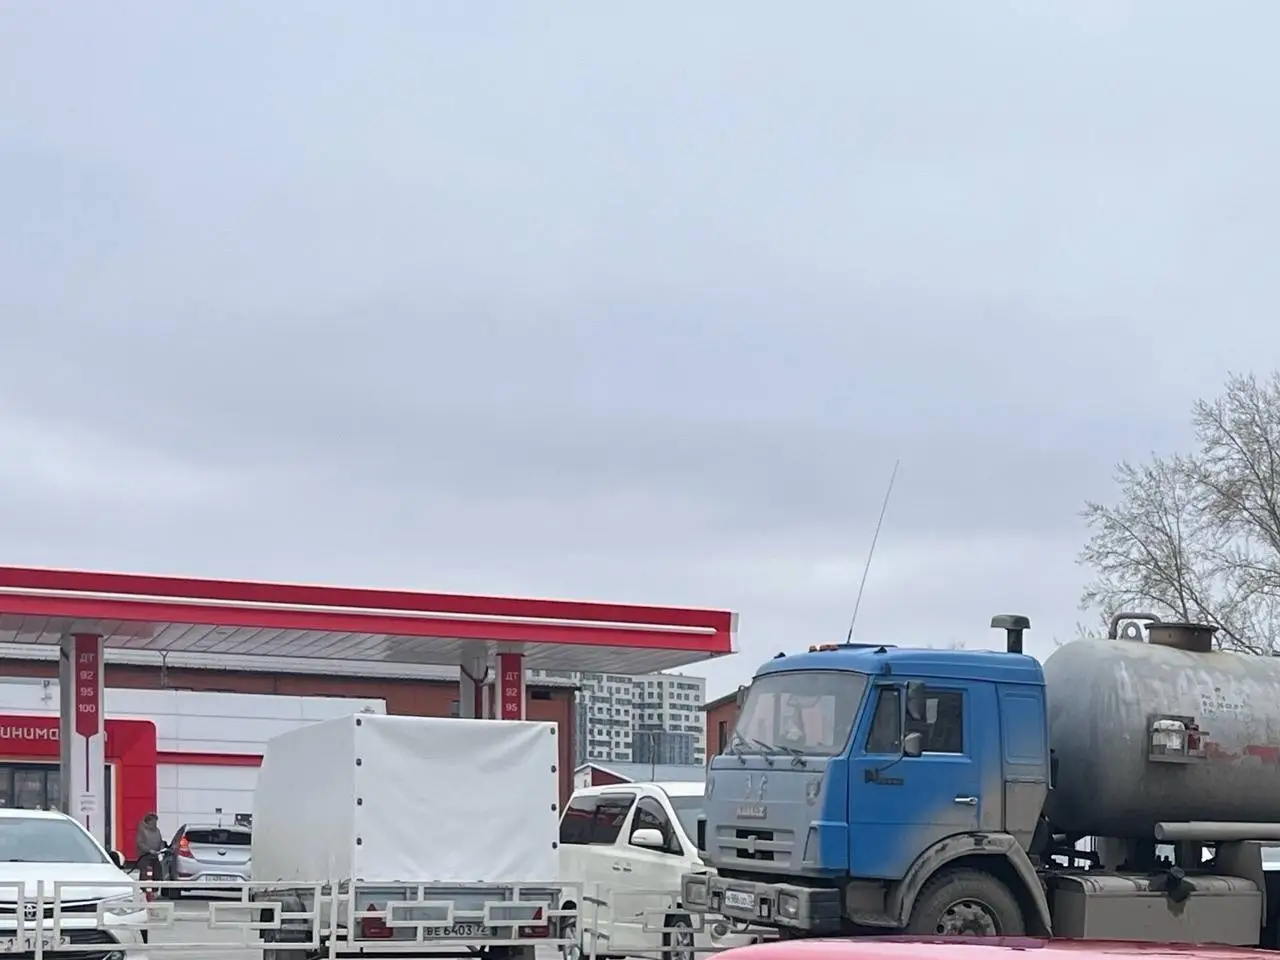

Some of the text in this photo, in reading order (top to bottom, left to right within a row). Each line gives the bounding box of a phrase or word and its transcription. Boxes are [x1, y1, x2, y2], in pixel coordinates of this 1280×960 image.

[80, 653, 95, 664] ДТ
[80, 671, 94, 681] 92
[504, 671, 519, 681] ДТ
[80, 687, 94, 697] 95
[505, 687, 518, 697] 92
[78, 703, 96, 713] 100
[505, 703, 518, 712] 95
